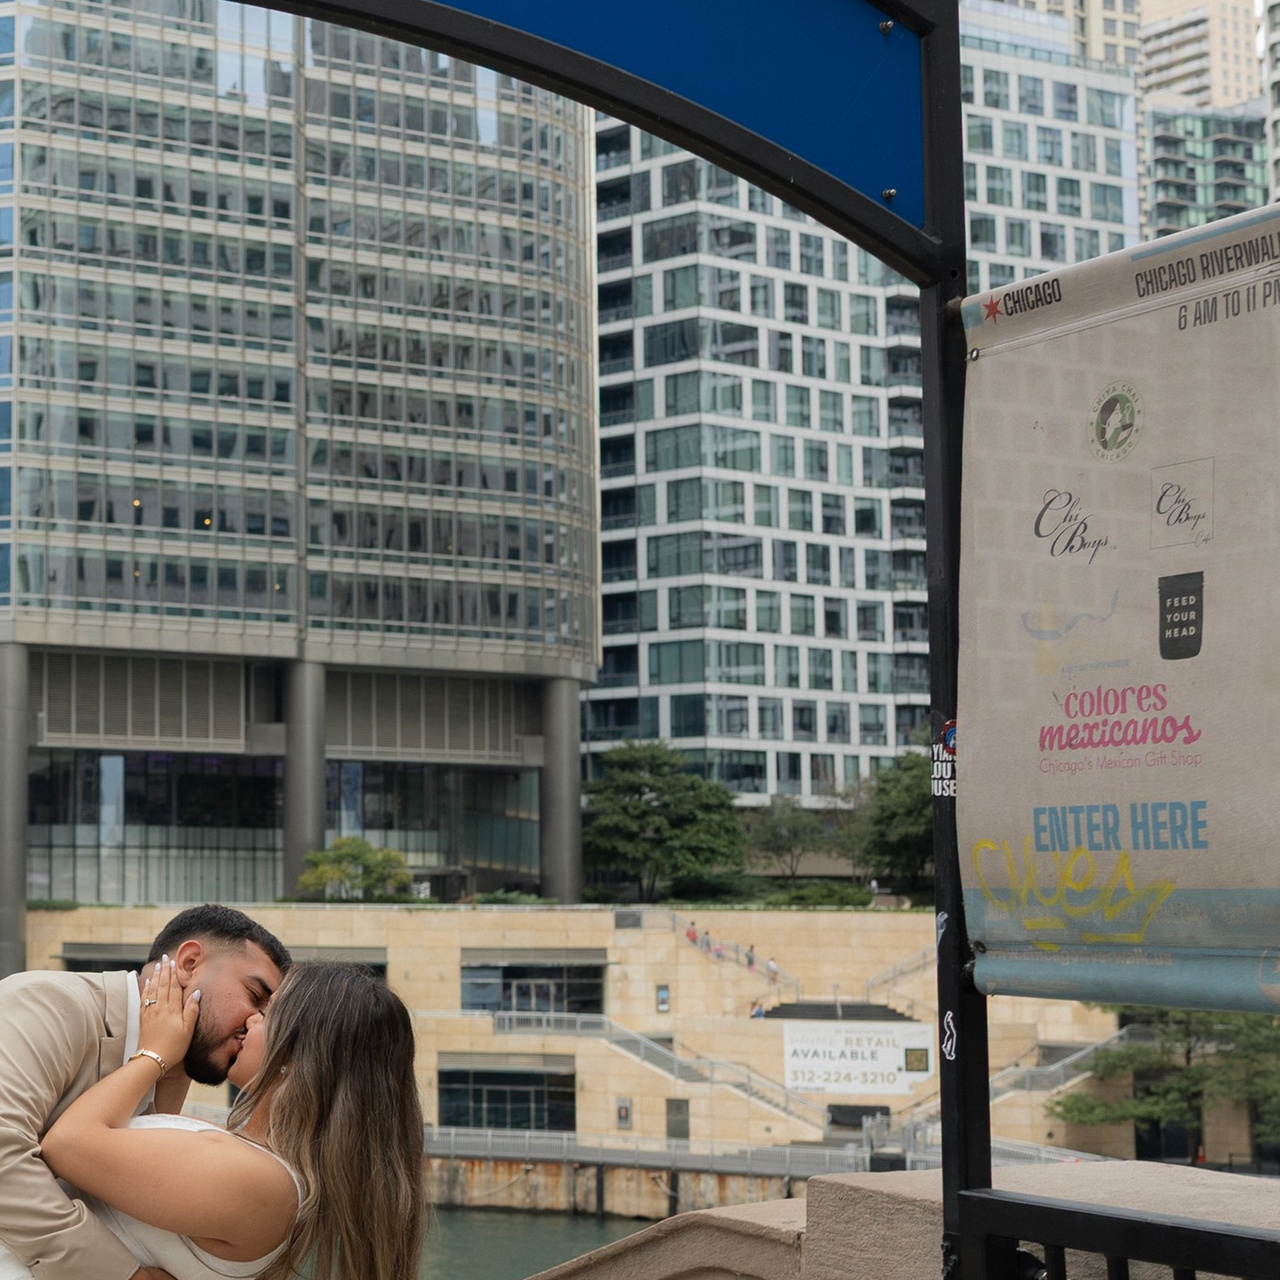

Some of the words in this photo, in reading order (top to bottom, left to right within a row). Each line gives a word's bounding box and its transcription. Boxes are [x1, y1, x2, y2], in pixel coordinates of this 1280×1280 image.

[1135, 257, 1197, 298] CHICAGO
[1003, 278, 1062, 317] CHICAGO
[1178, 304, 1188, 331] 6
[1193, 296, 1218, 328] AM
[1223, 289, 1240, 320] TO
[1246, 284, 1257, 313] 11
[1095, 441, 1133, 460] CHICAGO
[1166, 595, 1196, 608] FEED
[1166, 611, 1196, 623] YOUR
[1165, 626, 1196, 639] HEAD
[1064, 683, 1168, 719] colores
[1039, 715, 1202, 752] mexicanos
[1039, 756, 1093, 775] Chicago's
[1097, 754, 1141, 770] Mexican
[1144, 751, 1167, 768] Gift
[1172, 749, 1203, 768] Shop
[1033, 803, 1121, 852] ENTER
[1130, 800, 1209, 851] HERE
[844, 1037, 900, 1048] RETAIL
[791, 1049, 879, 1061] AVAILABLE
[791, 1070, 897, 1084] 312-224-3210
